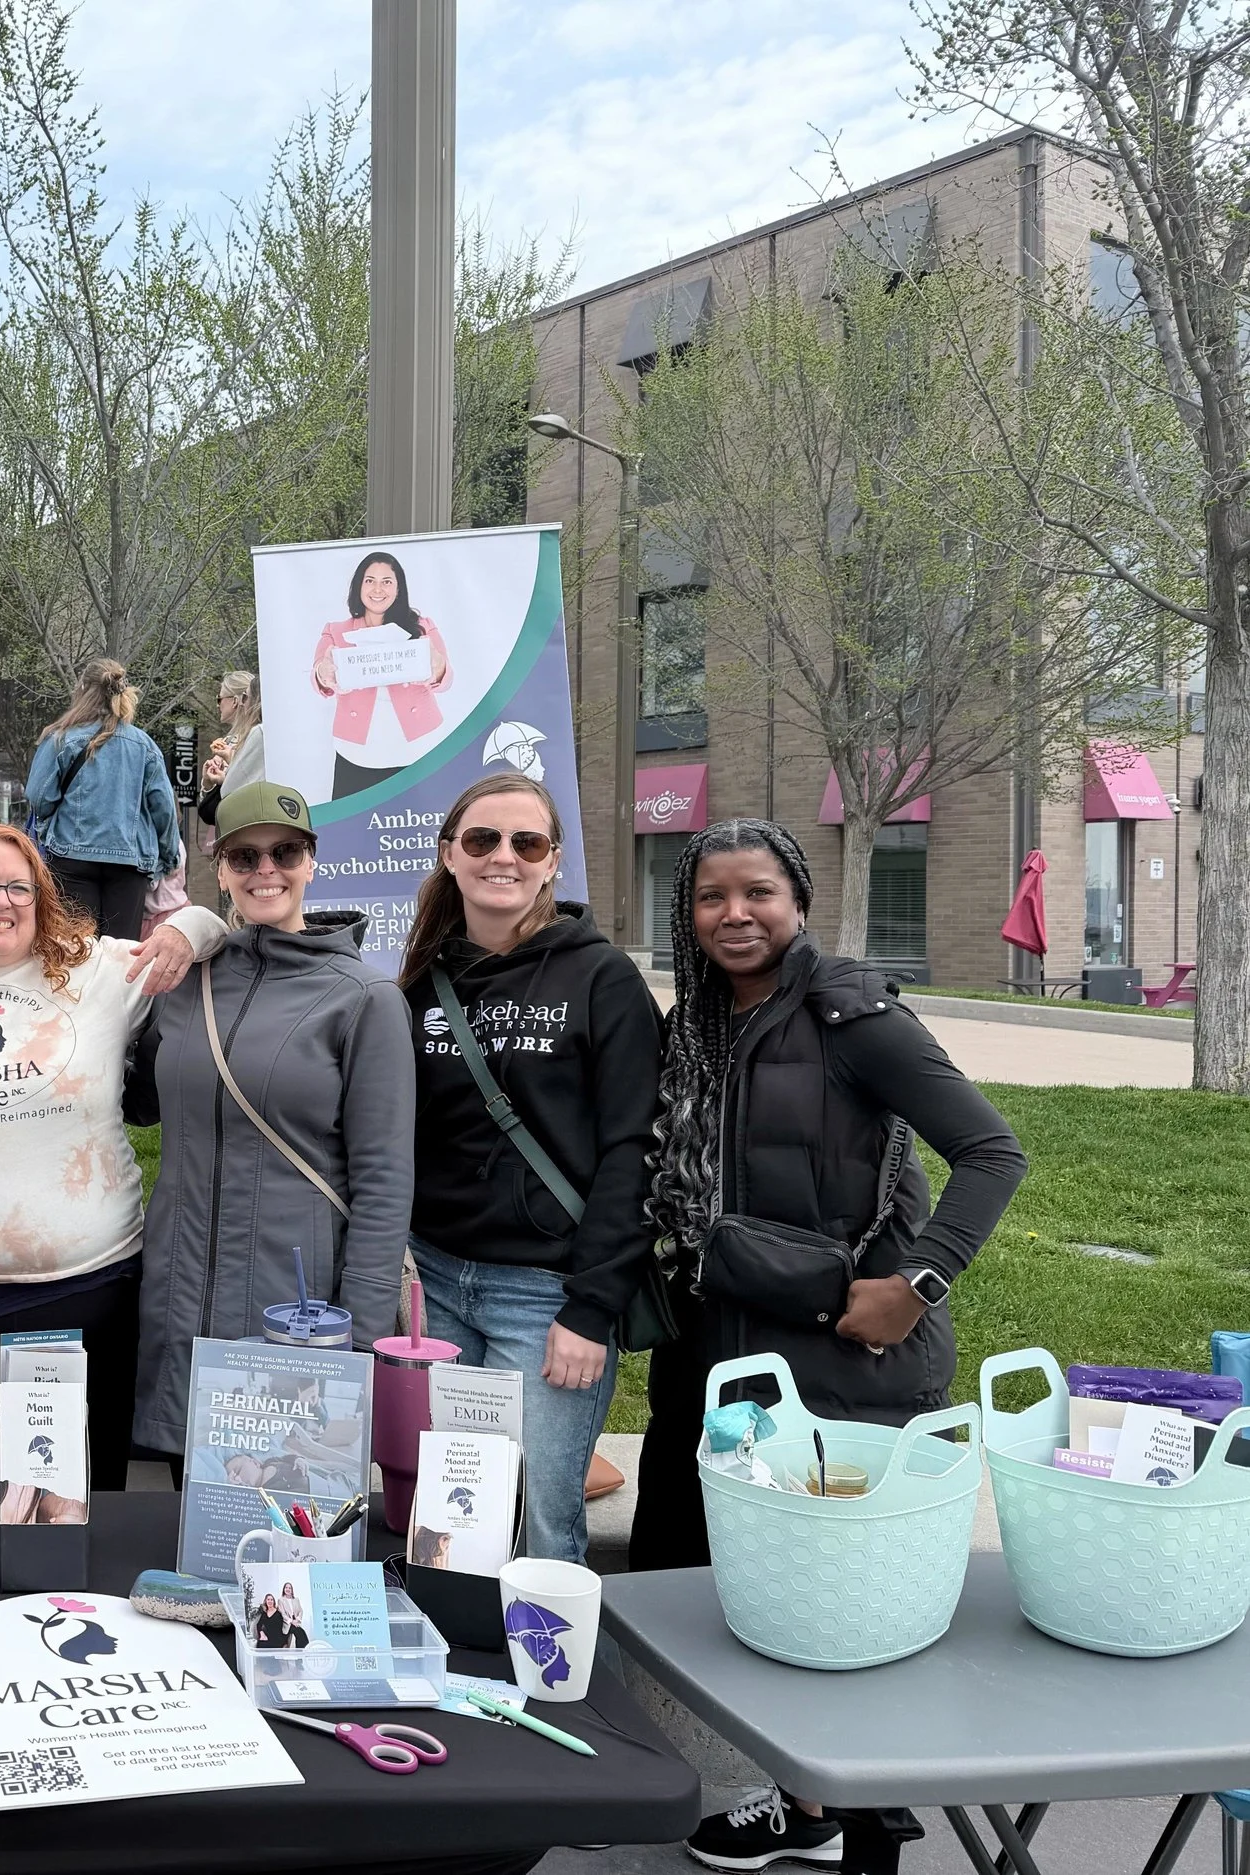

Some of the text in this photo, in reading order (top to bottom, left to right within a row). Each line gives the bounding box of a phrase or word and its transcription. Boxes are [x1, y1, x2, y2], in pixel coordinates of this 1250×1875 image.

[175, 741, 194, 786] Chill
[366, 808, 445, 830] Amber
[474, 1020, 566, 1038] NIVERSITY
[250, 1355, 286, 1364] STRUGGLING
[322, 1362, 346, 1370] MENTAL
[264, 1364, 290, 1372] LOOKING
[26, 1402, 53, 1413] Mom
[210, 1391, 315, 1417] PERINATAL
[28, 1416, 54, 1426] Guilt
[453, 1406, 500, 1424] EMDR
[209, 1413, 295, 1436] THERAPY
[1159, 1420, 1176, 1429] What
[208, 1431, 270, 1451] CLINIC
[1150, 1435, 1191, 1452] Mood and
[1153, 1427, 1191, 1444] Perinatal
[446, 1449, 480, 1458] Perinatal
[1144, 1451, 1190, 1470] Disorders?
[1152, 1444, 1185, 1460] Anxiety
[444, 1457, 466, 1466] Mood
[1060, 1452, 1112, 1470] Resista
[442, 1475, 482, 1484] Disorders?
[447, 1467, 477, 1477] Anxiety
[39, 1700, 191, 1728] Care INC.
[27, 1723, 208, 1745] Women's Health Reimagined
[102, 1740, 260, 1759] Get on the list to keep up
[113, 1759, 126, 1767] to
[129, 1757, 158, 1765] date
[180, 1753, 201, 1761] our
[205, 1749, 258, 1759] services
[153, 1759, 227, 1772] and events!
